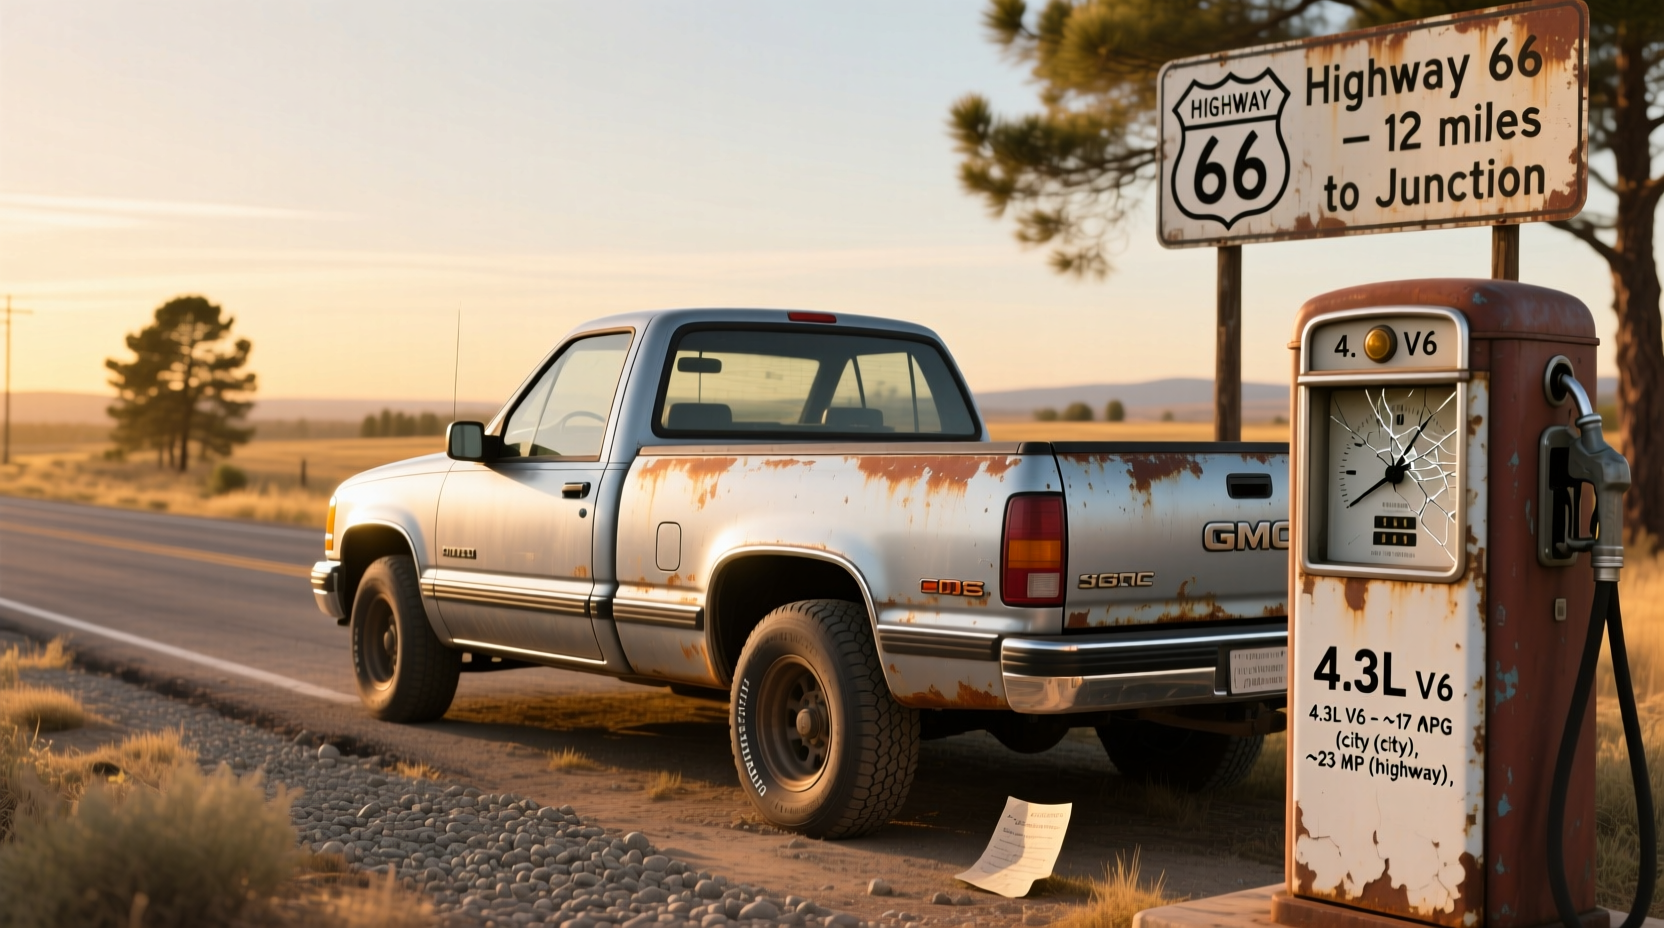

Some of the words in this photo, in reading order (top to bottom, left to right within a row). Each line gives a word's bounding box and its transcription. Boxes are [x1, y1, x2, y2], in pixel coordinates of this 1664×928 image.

[1306, 54, 1470, 111] Highway
[1489, 34, 1542, 81] 66
[1191, 89, 1271, 119] HIGHWAY
[1385, 110, 1421, 151] 12
[1440, 102, 1541, 147] miles
[1194, 130, 1267, 204] 66
[1324, 175, 1359, 212] to
[1376, 158, 1545, 208] Junction
[1334, 334, 1356, 357] 4.
[1403, 330, 1438, 356] V6
[1203, 520, 1289, 552] GMC
[1314, 646, 1406, 697] 4.3L
[1415, 670, 1453, 701] V6
[1309, 704, 1342, 723] 4.3L
[1345, 707, 1366, 725] V6
[1336, 730, 1369, 753] (city
[1306, 750, 1336, 768] ~23
[1341, 753, 1364, 771] MP
[1369, 756, 1454, 787] (highway),
